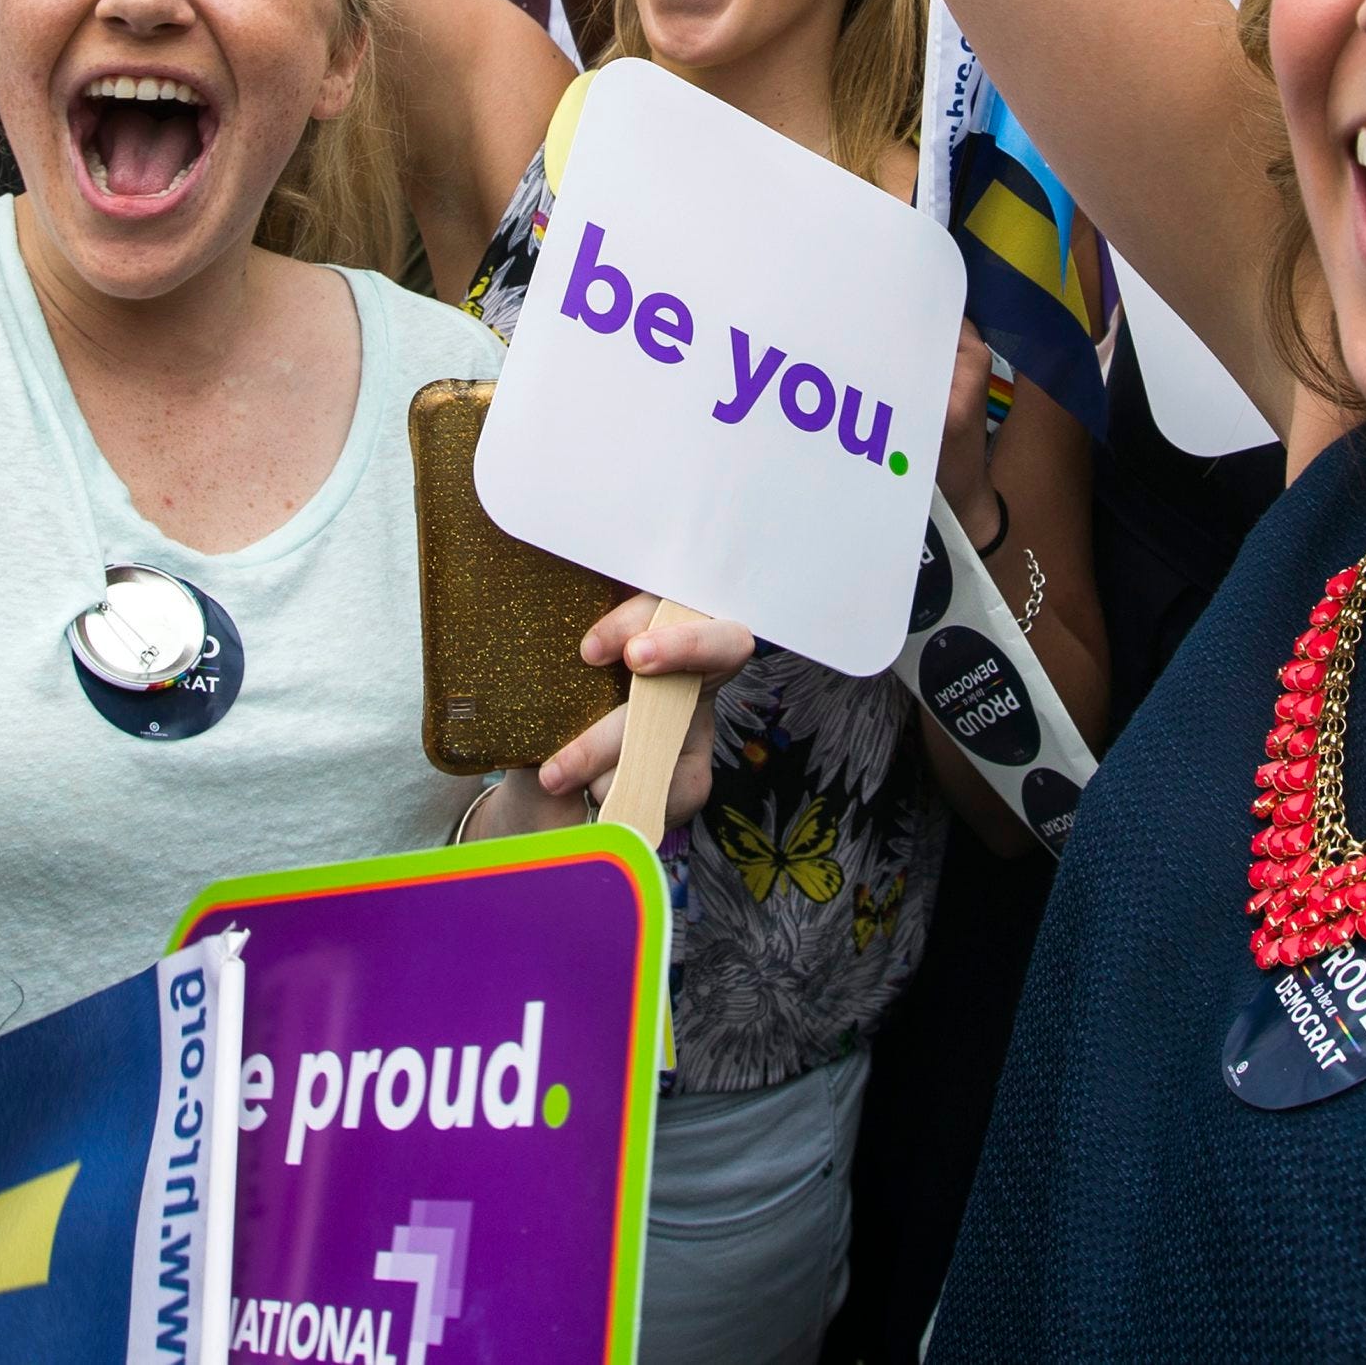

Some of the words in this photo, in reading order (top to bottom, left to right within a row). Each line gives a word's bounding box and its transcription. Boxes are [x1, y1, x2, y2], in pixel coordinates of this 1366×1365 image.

[560, 221, 694, 364] be
[711, 325, 908, 476] you.
[935, 658, 999, 708] DEMOCRAT
[956, 687, 1021, 736] PROUD
[1274, 973, 1347, 1071] DEMOCRAT
[237, 1053, 274, 1131] e
[285, 1000, 571, 1166] proud.
